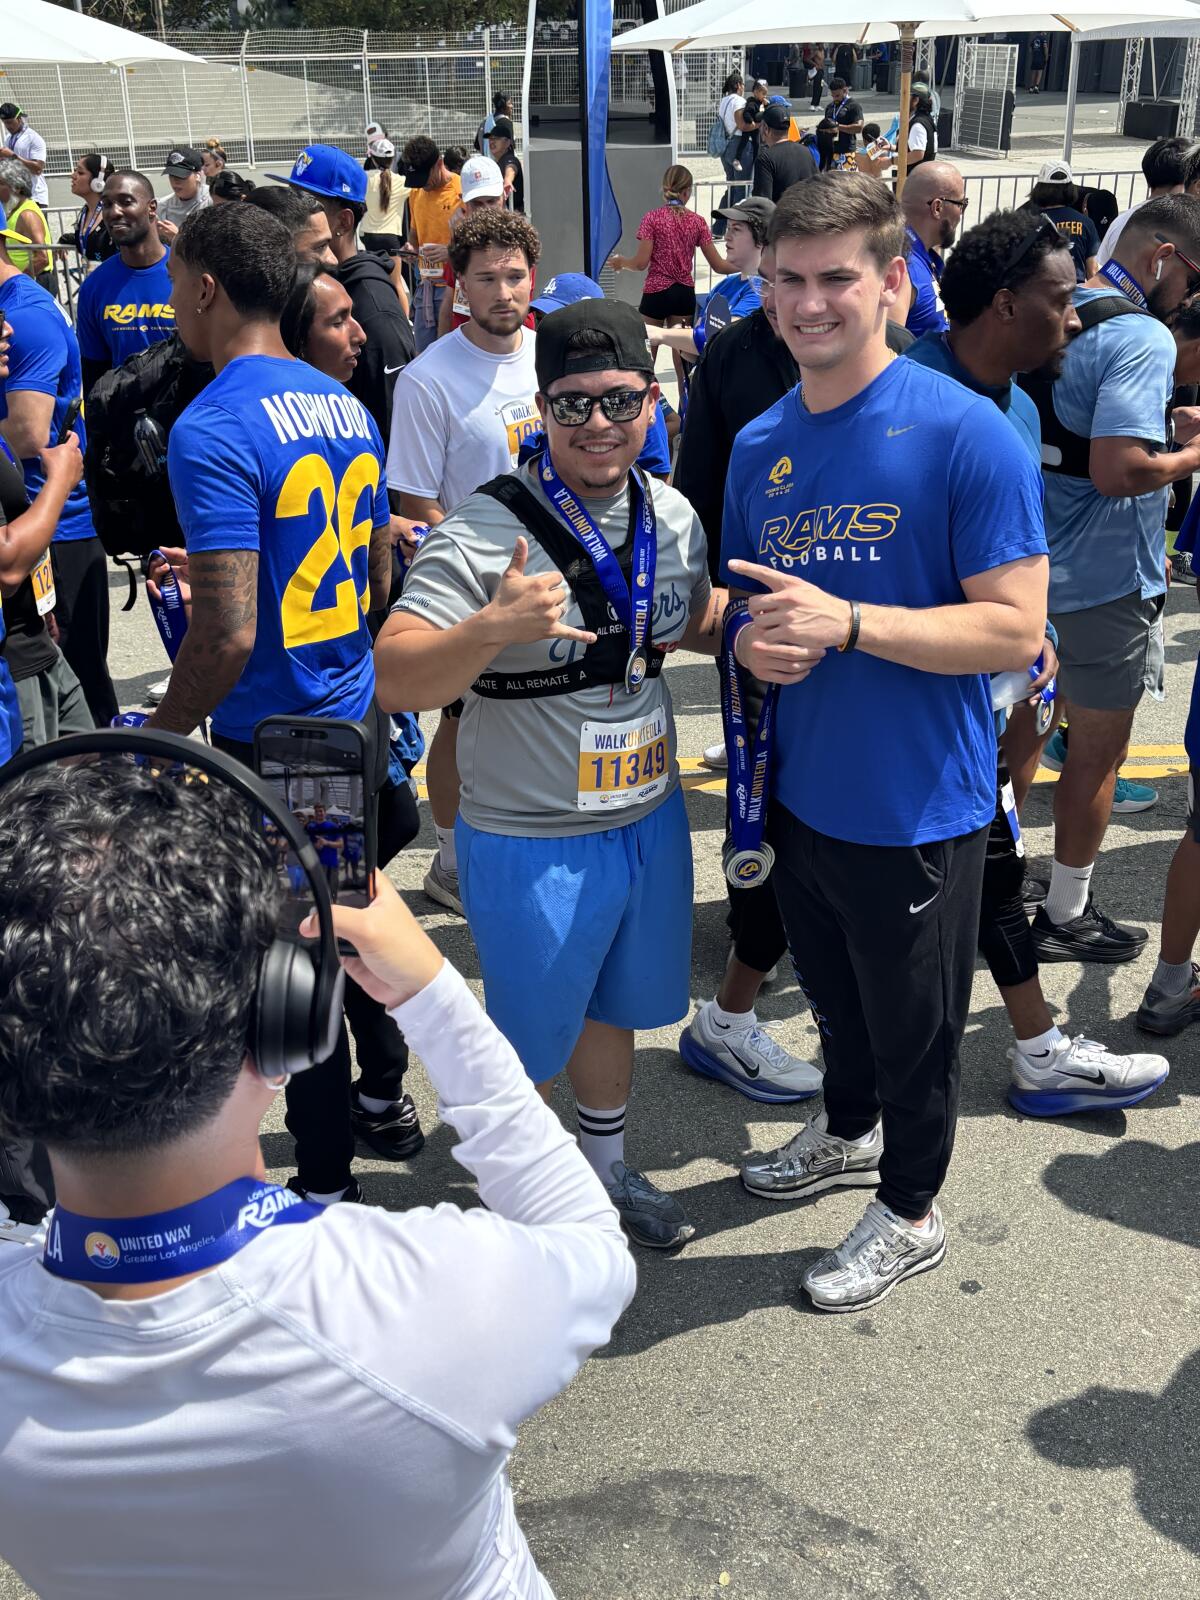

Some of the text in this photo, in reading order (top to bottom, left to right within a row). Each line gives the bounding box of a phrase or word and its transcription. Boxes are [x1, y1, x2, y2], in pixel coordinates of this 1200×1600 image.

[103, 303, 176, 324] RAMS
[553, 488, 608, 562] WALKUNITEDLA
[759, 503, 901, 560] RAMS
[275, 453, 381, 649] 26
[769, 546, 881, 569] FOOBALL
[506, 681, 525, 690] ALL
[526, 674, 571, 689] REMATE
[595, 720, 662, 749] WALKUNITEDLA
[592, 741, 665, 789] 11349
[736, 783, 746, 819] RAMS
[747, 751, 768, 823] WALKUNITEDLA
[119, 1224, 191, 1252] UNITED WAY
[124, 1234, 216, 1264] Greater Los Angeles
